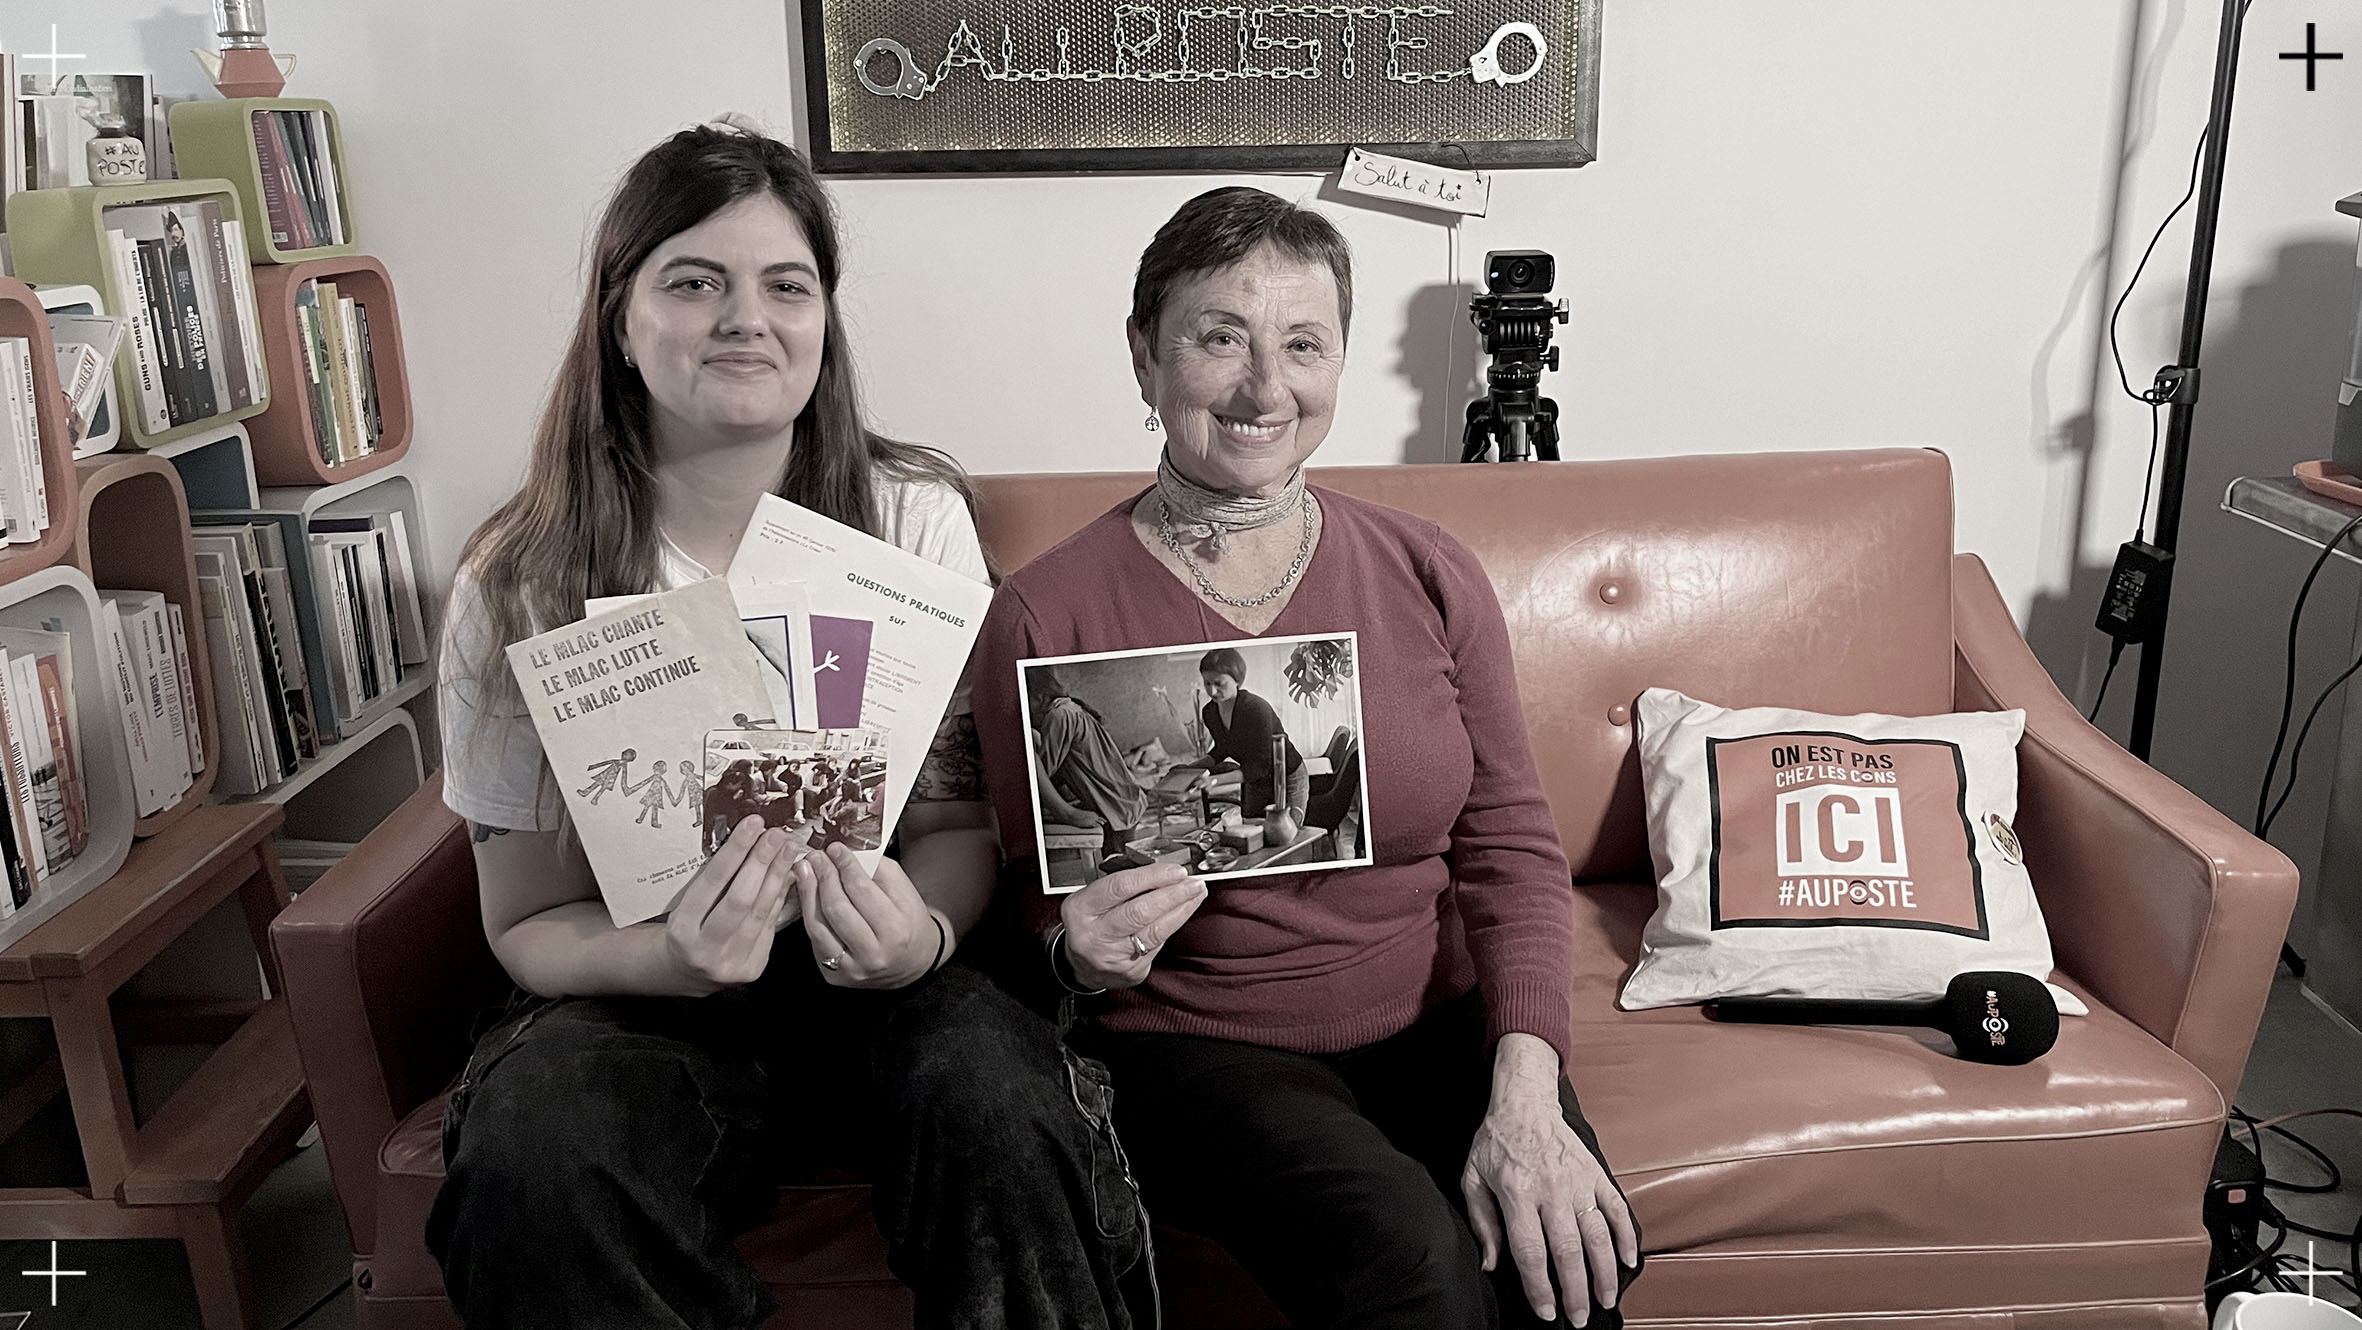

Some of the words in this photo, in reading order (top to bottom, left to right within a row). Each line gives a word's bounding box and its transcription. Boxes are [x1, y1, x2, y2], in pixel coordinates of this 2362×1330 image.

[97, 158, 146, 177] POSTE
[1355, 161, 1413, 191] Salut
[1418, 179, 1430, 195] à
[1434, 178, 1462, 202] toi
[132, 316, 144, 349] ROSES
[141, 364, 152, 391] GUNS
[847, 572, 907, 603] QUESTIONS
[909, 598, 966, 628] PRATIQUES
[889, 615, 907, 626] sur
[529, 648, 551, 669] LE
[553, 631, 599, 661] MLAC
[602, 609, 665, 643] CHANTE
[160, 658, 177, 691] LUTTES
[542, 674, 564, 697] LE
[564, 658, 610, 688] MLAC
[611, 638, 663, 671] LUTTE
[0, 669, 8, 708] CASTANE
[149, 672, 164, 719] L'EMPRISE
[166, 691, 178, 704] DE
[553, 701, 576, 723] LE
[576, 685, 621, 714] MLAC
[623, 655, 701, 697] CONTINUE
[5, 709, 14, 737] VICTOR
[168, 704, 183, 738] TERRES
[1772, 745, 1801, 769] ON
[1807, 745, 1845, 765] EST
[1851, 752, 1894, 769] PAS
[1775, 765, 1815, 788] CHEZ
[1818, 765, 1847, 780] LES
[1850, 770, 1897, 784] CONS
[1785, 794, 1897, 863] ICI
[1778, 878, 1917, 908] #AUPOSTE
